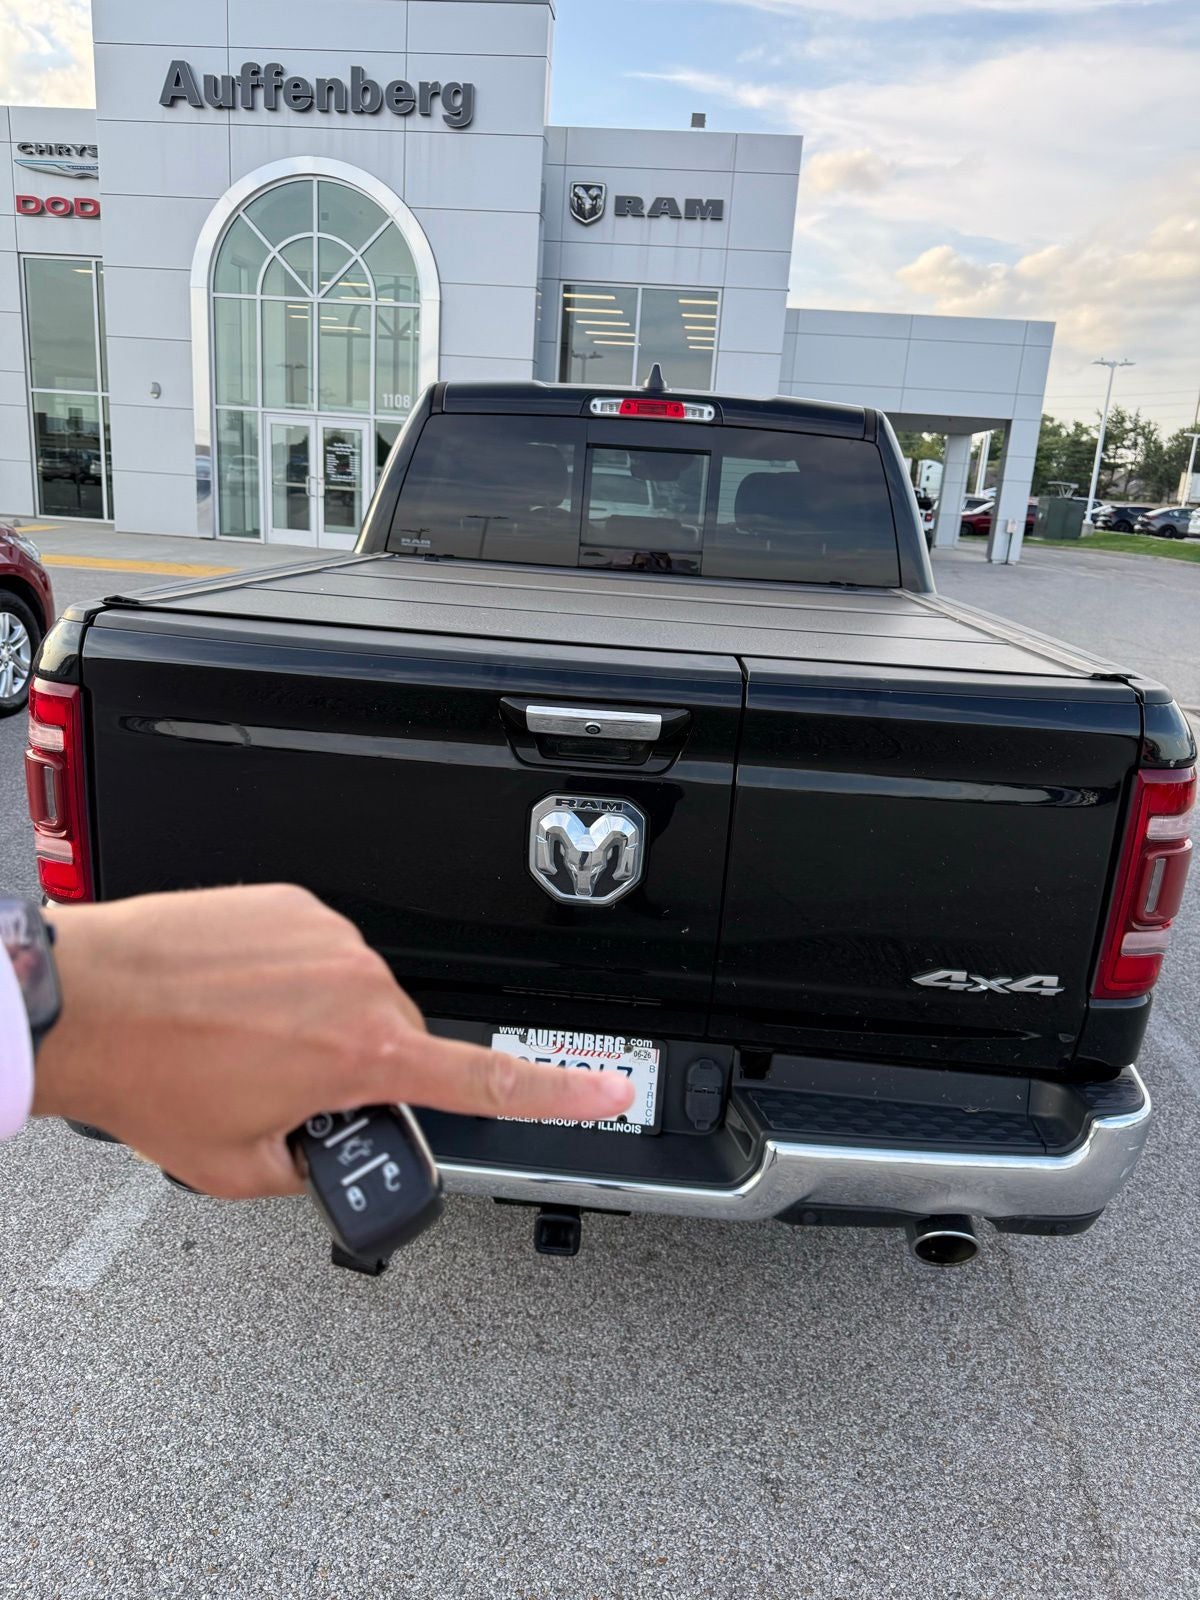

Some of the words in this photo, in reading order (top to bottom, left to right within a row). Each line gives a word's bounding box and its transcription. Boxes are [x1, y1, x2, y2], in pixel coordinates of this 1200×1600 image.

[159, 60, 475, 128] Auffenberg
[16, 195, 100, 217] DOD
[614, 195, 724, 220] RAM
[383, 393, 410, 408] 1108
[556, 799, 624, 812] RAM
[633, 1050, 652, 1060] 06-26
[649, 1064, 656, 1074] B
[645, 1082, 654, 1126] TRUCK
[541, 1117, 579, 1128] GROUP
[581, 1120, 596, 1130] OF
[598, 1121, 642, 1135] ILLINOIS
